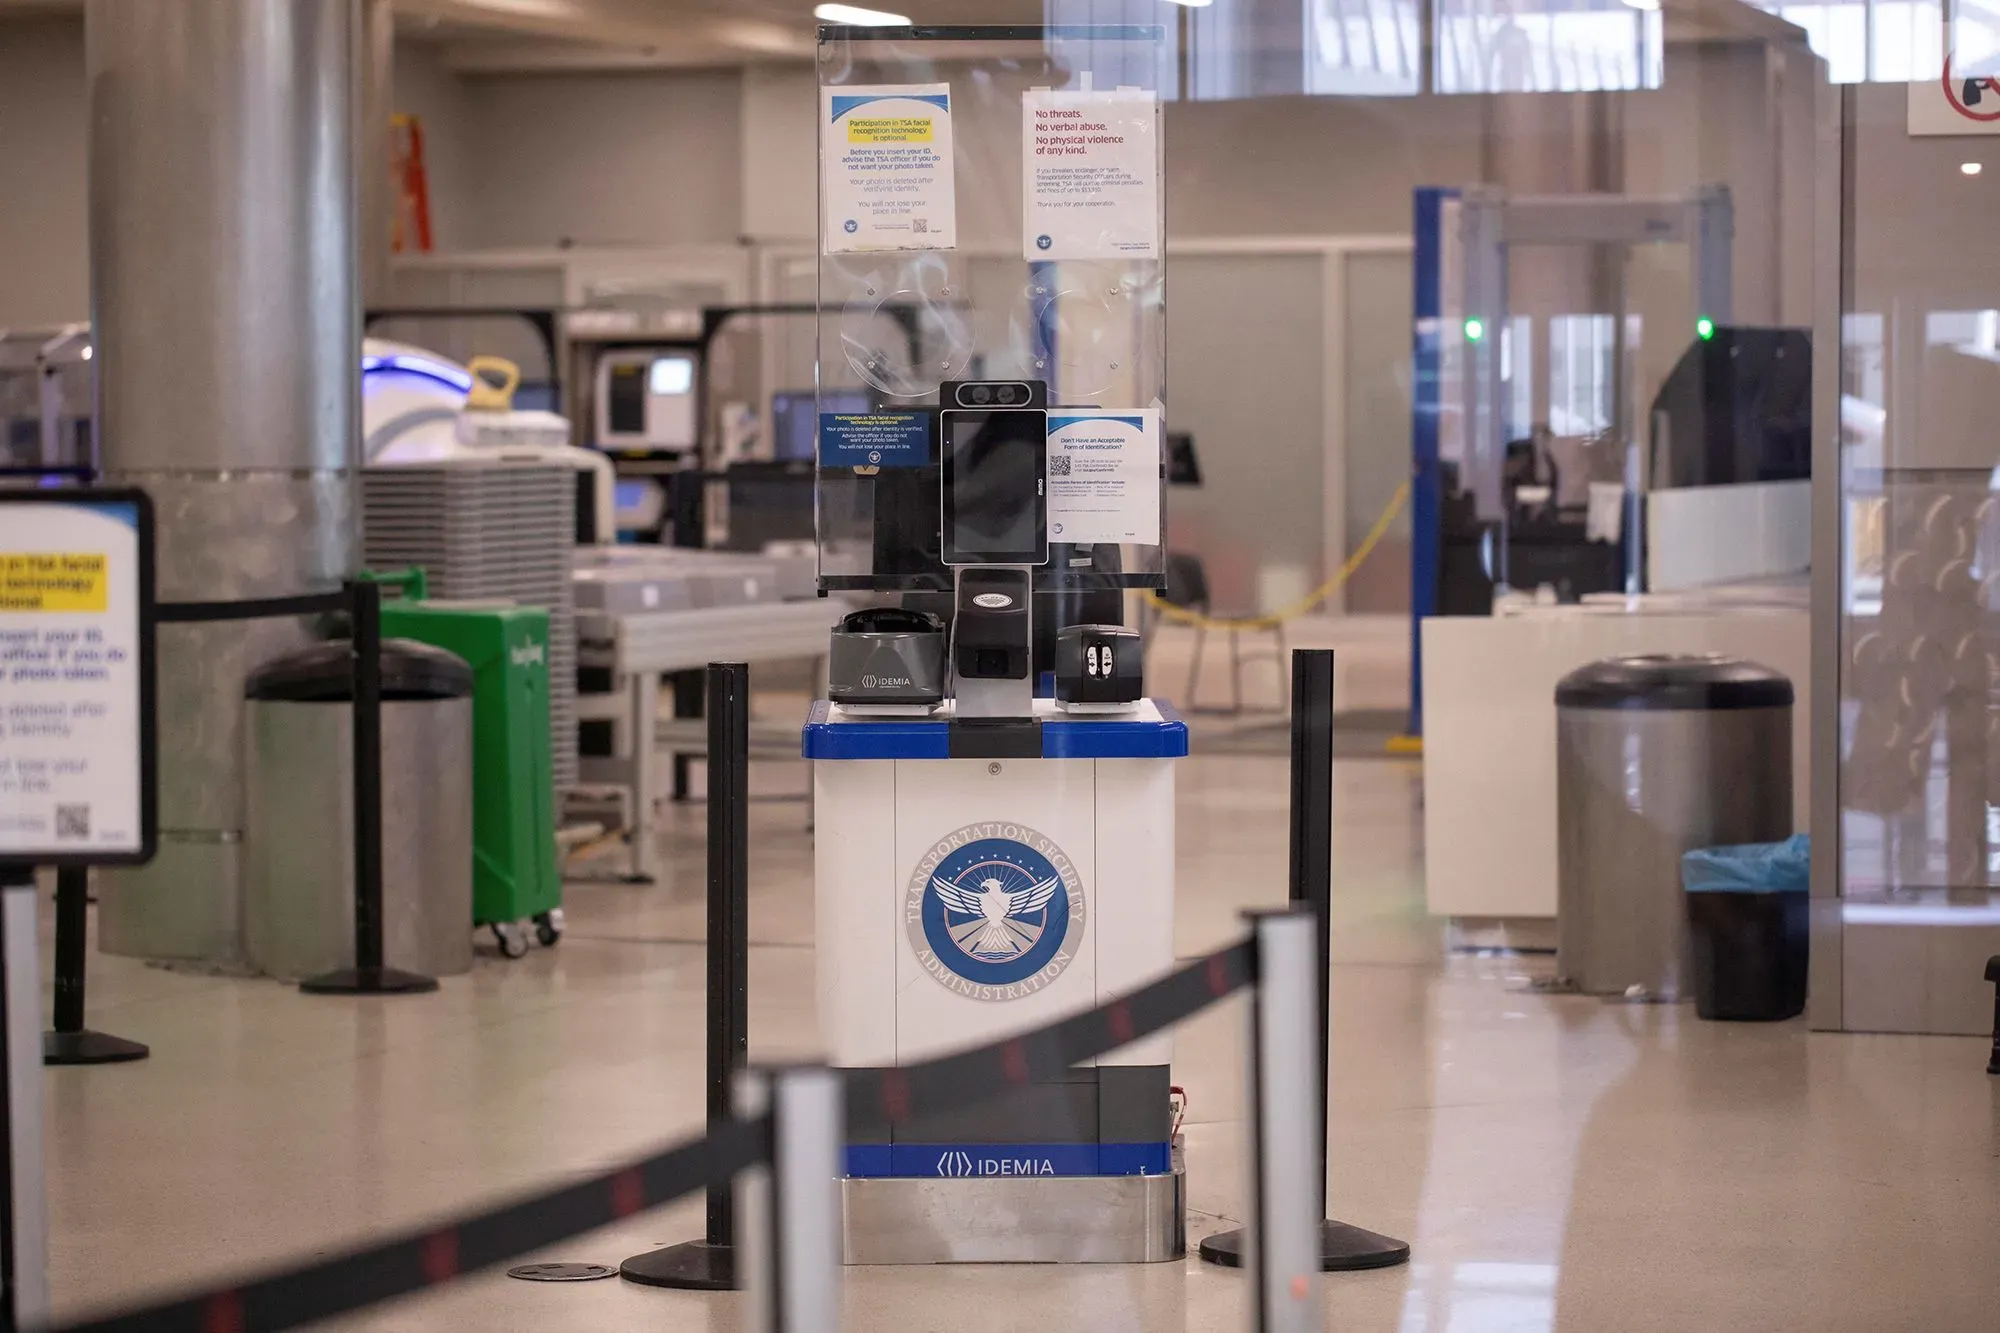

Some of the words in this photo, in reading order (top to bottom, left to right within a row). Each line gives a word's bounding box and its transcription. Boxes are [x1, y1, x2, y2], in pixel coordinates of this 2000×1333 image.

[1050, 110, 1082, 118] threats.
[1050, 123, 1077, 131] verbal
[1050, 136, 1085, 145] physical
[1047, 148, 1063, 156] any
[907, 824, 1033, 923] TRANSPORTATION
[1036, 839, 1083, 923] SECURITY
[917, 949, 1072, 1000] ADMINISTRATION
[979, 1159, 1054, 1175] IDEMIA
